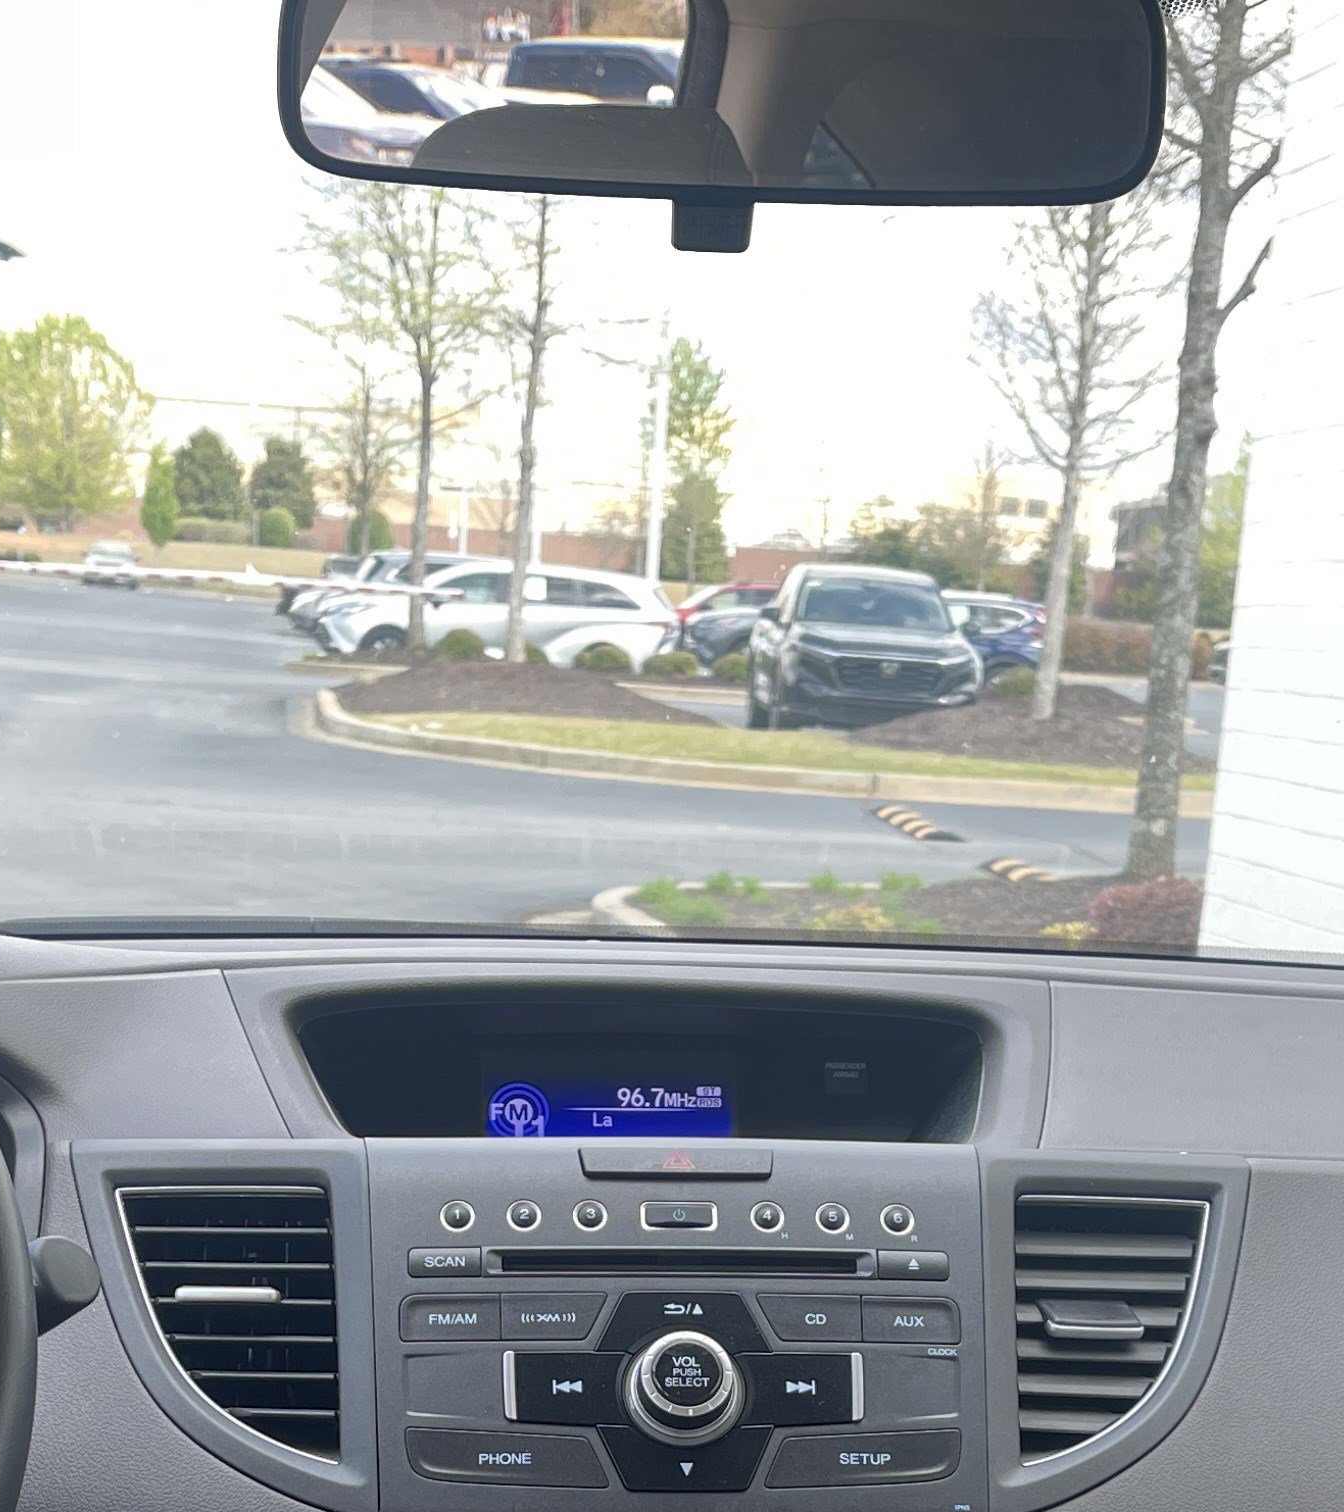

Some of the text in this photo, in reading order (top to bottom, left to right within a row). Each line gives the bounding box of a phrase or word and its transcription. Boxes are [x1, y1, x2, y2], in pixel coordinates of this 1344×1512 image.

[592, 1112, 613, 1127] La
[454, 1209, 461, 1220] 1
[519, 1208, 529, 1220] 2
[585, 1208, 596, 1220] 3
[762, 1209, 773, 1221] 4
[828, 1211, 838, 1222] 5
[893, 1213, 904, 1224] 6
[780, 1232, 789, 1240] H
[845, 1233, 854, 1241] M
[910, 1234, 918, 1243] R
[424, 1256, 466, 1268] SCAN
[428, 1313, 478, 1325] FM/AM
[805, 1313, 827, 1325] CD
[893, 1315, 925, 1327] AUX
[927, 1347, 958, 1356] CLOCK
[672, 1356, 700, 1368] VOL
[672, 1367, 702, 1377] PUSH
[664, 1377, 710, 1388] SELECT
[478, 1453, 532, 1465] PHONE
[839, 1452, 892, 1465] SETUP
